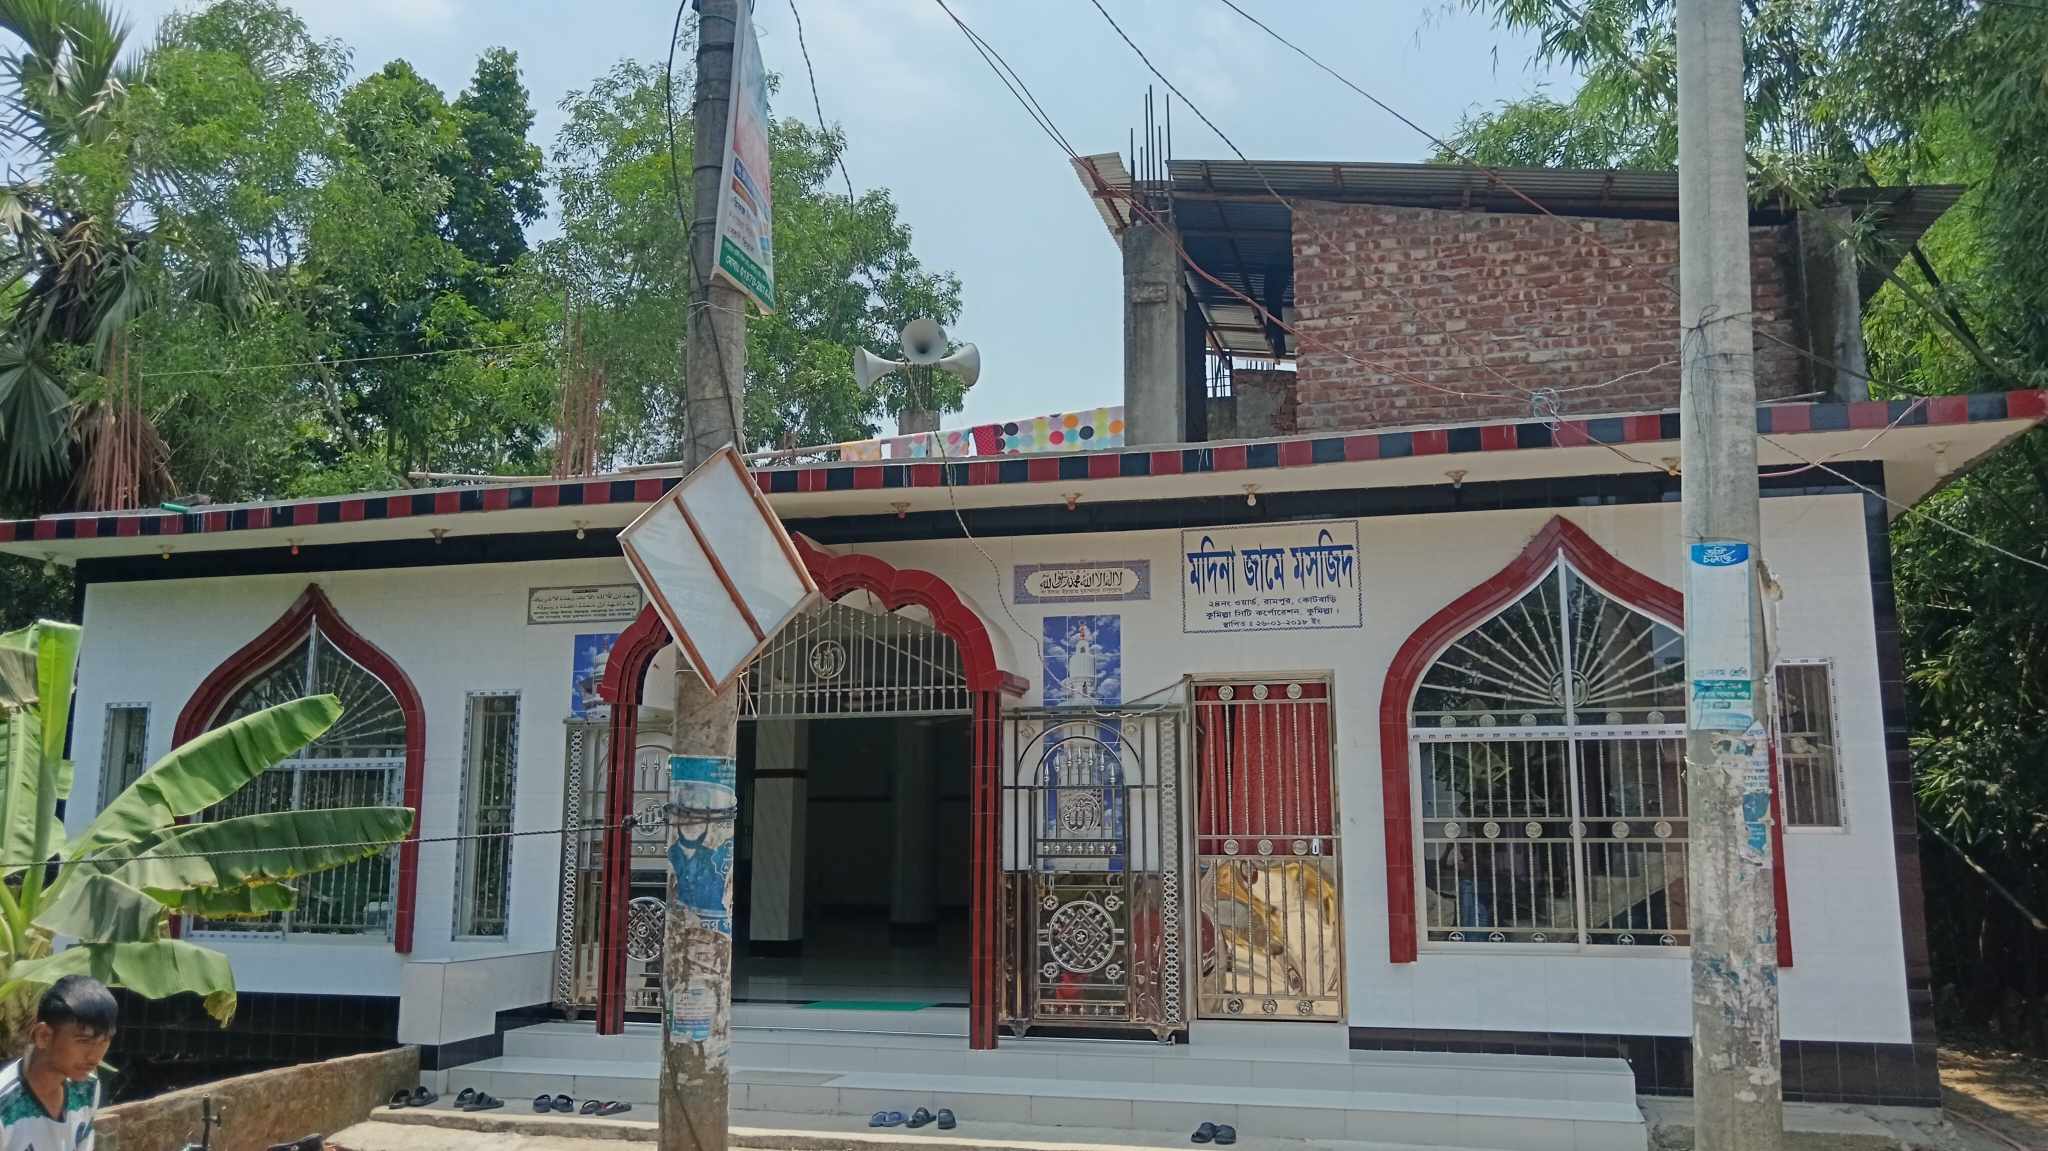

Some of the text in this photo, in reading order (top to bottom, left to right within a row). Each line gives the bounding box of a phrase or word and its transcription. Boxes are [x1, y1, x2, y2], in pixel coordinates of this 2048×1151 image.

[1187, 528, 1354, 594] মদিনা জামে মসজিদ
[1205, 610, 1232, 620] কুমিল্লা
[1234, 608, 1252, 617] সিটি
